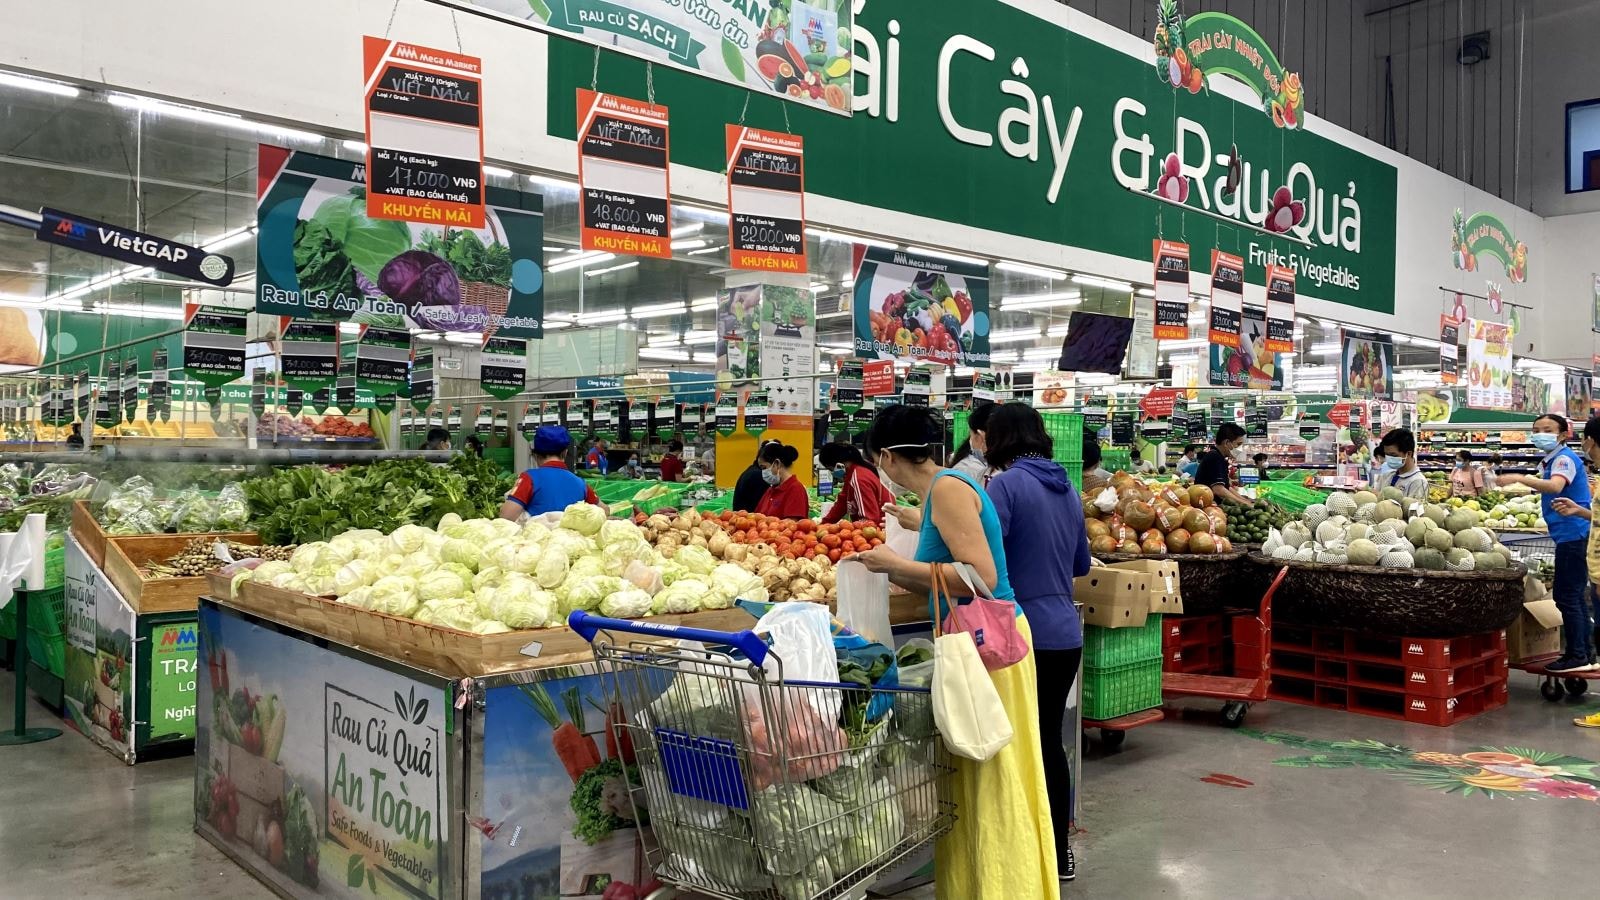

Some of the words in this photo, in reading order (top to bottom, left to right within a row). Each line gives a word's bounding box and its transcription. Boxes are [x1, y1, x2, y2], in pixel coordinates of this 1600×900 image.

[579, 9, 604, 23] RAU
[608, 11, 624, 26] CỦ
[627, 13, 678, 50] SẠCH
[723, 18, 748, 49] ăn
[1188, 32, 1212, 57] TRÁI
[1213, 29, 1233, 50] CÂY
[420, 53, 444, 65] Mega
[445, 59, 478, 71] Market
[937, 34, 1083, 205] Cây
[1111, 96, 1155, 191] &
[1176, 116, 1269, 224] Rau
[1287, 161, 1361, 254] Quả
[399, 155, 408, 164] Kg
[409, 156, 426, 166] (Each
[389, 166, 449, 189] 17.000
[452, 176, 477, 189] VNĐ
[385, 187, 404, 195] +VAT
[406, 188, 426, 198] (BAO
[427, 189, 444, 200] GỒM
[446, 190, 469, 204] THUẾ)
[383, 202, 442, 220] KHUYẾN
[445, 207, 471, 224] MÃI
[593, 204, 640, 224] 18.600
[646, 213, 665, 223] VNĐ
[595, 222, 610, 230] +VAT
[611, 223, 626, 232] (BAO
[741, 226, 784, 244] 22.000
[784, 234, 801, 242] VNĐ
[97, 227, 189, 263] VietGAP
[593, 236, 640, 251] KHUYẾN
[641, 239, 661, 254] MÃI
[741, 255, 779, 268] KHUYẾN
[781, 257, 798, 269] MÃI
[1248, 242, 1286, 267] Fruits
[1299, 255, 1360, 291] Vegetables
[261, 284, 300, 306] Rau
[304, 289, 328, 308] Lá
[333, 293, 361, 315] An
[366, 295, 406, 316] Toàn
[425, 308, 458, 323] Safety
[461, 312, 489, 327] Leafy
[491, 316, 539, 329] Vegetable
[855, 337, 872, 351] Rau
[892, 343, 903, 354] An
[331, 701, 362, 746] Rau
[366, 717, 388, 758] Củ
[393, 728, 433, 778] Quả
[331, 752, 365, 813] An
[370, 767, 434, 850] Toàn
[331, 809, 349, 836] Safe
[349, 821, 373, 849] Foods
[382, 839, 433, 885] Vegetables
